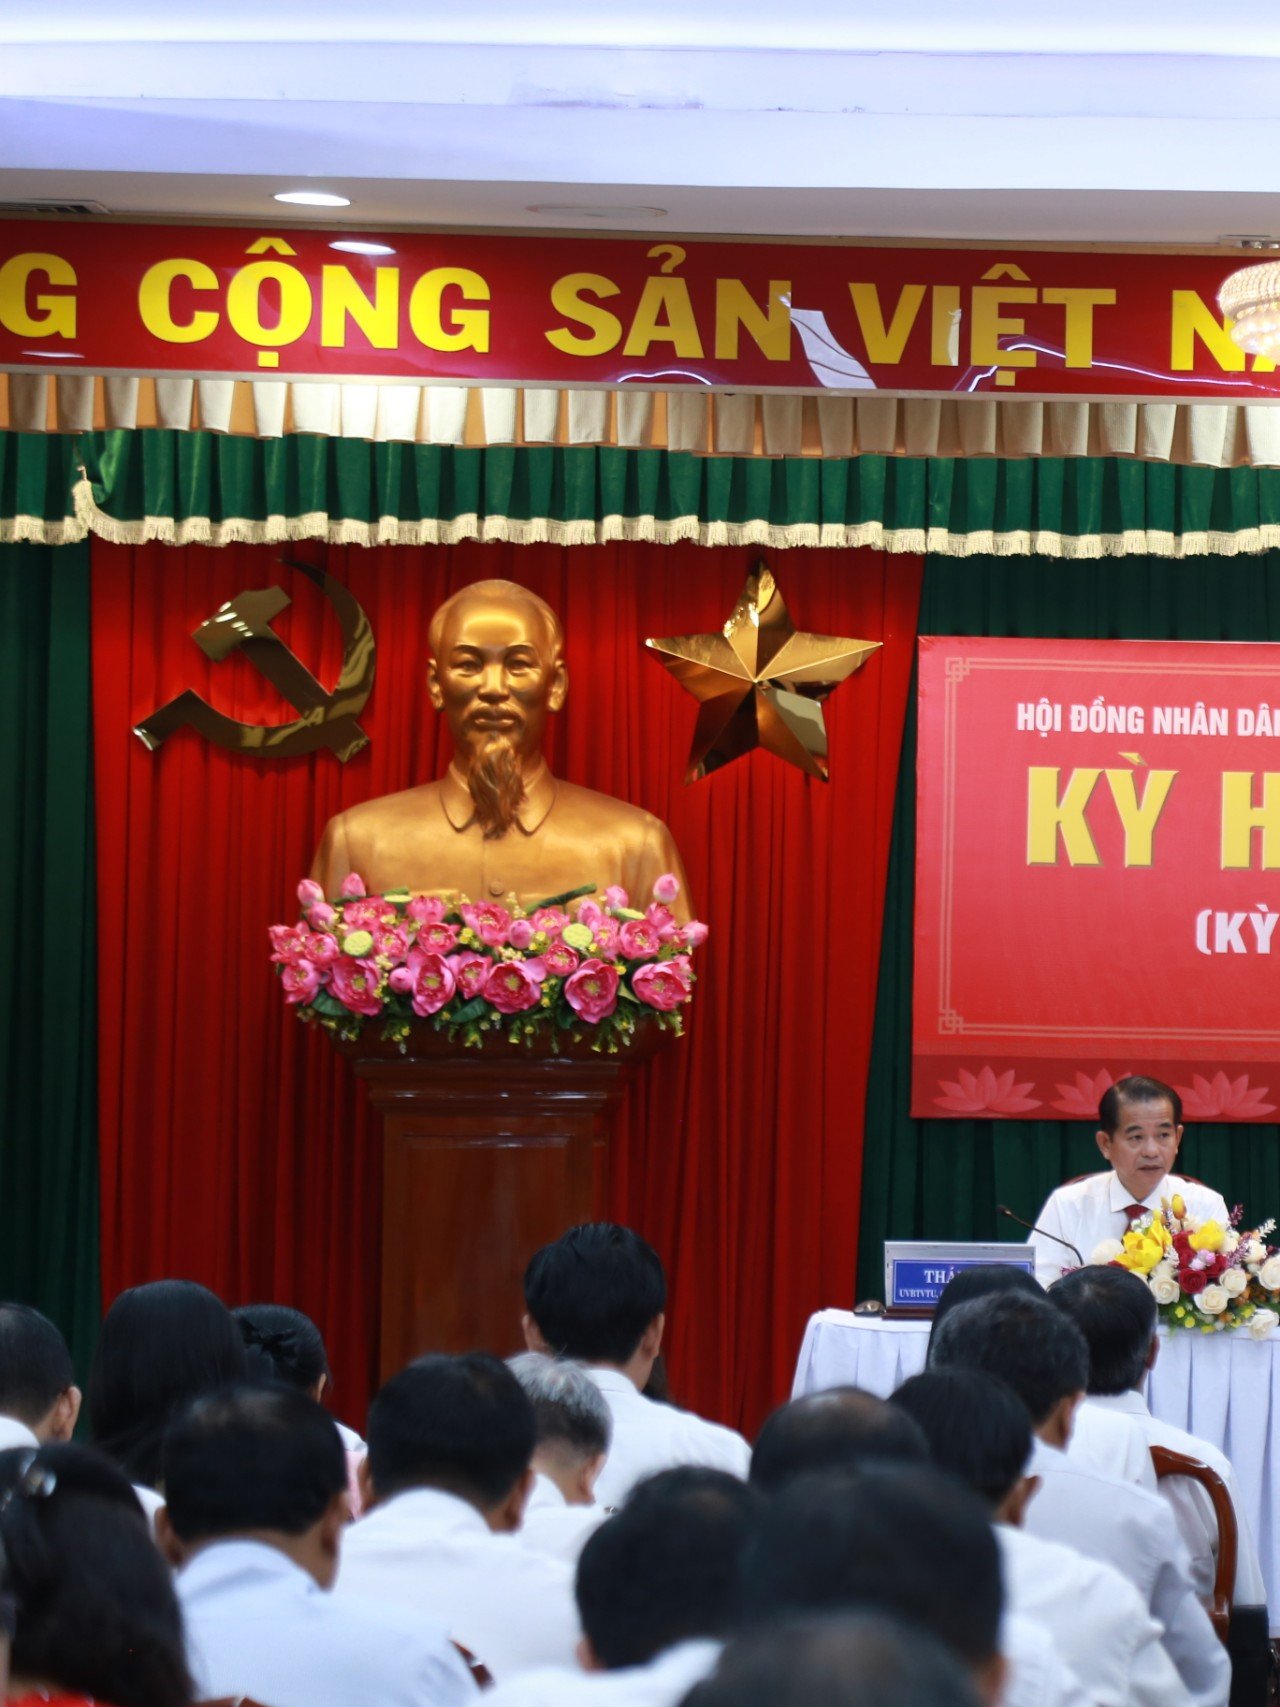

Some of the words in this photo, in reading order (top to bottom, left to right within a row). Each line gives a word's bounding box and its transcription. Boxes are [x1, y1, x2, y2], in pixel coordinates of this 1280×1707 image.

[138, 236, 491, 368] CỘNG
[544, 243, 792, 363] SẢN
[848, 263, 1117, 387] VIỆT
[1016, 696, 1062, 738] HỘI
[1070, 695, 1145, 735] ĐỒNG
[1153, 701, 1229, 737] NHÂN
[1026, 751, 1181, 868] KỲ
[1195, 903, 1280, 956] (KỲ
[924, 1265, 960, 1284] THÁ
